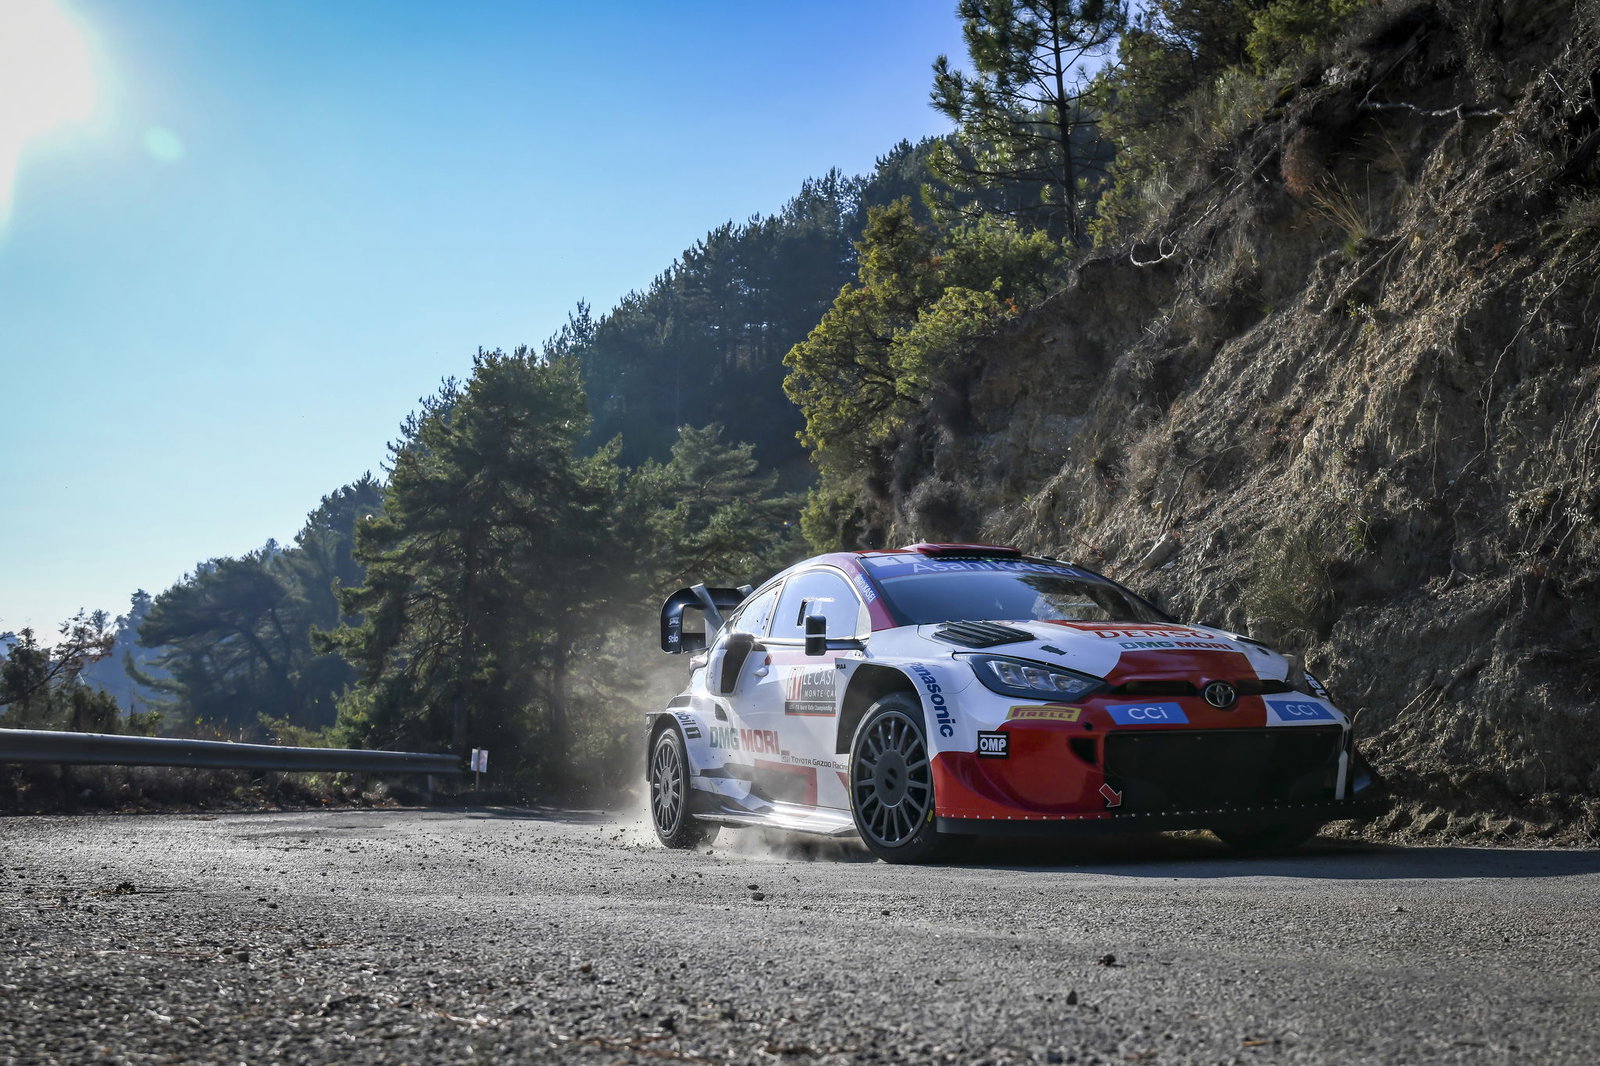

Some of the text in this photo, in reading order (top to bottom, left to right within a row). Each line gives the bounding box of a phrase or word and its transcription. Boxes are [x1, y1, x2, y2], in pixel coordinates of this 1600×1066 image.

[1094, 630, 1216, 640] DENSO
[1118, 641, 1235, 650] DMG MORI
[802, 671, 812, 685] LE
[804, 689, 824, 698] MONTE
[910, 661, 957, 738] Panasonic
[675, 710, 697, 726] obil
[1011, 707, 1075, 719] PIRELLI
[1128, 706, 1169, 720] CCi
[709, 726, 780, 754] DMG MORI
[979, 738, 1007, 751] OMP
[791, 756, 812, 765] TOYOTA
[812, 758, 832, 768] GAZOO
